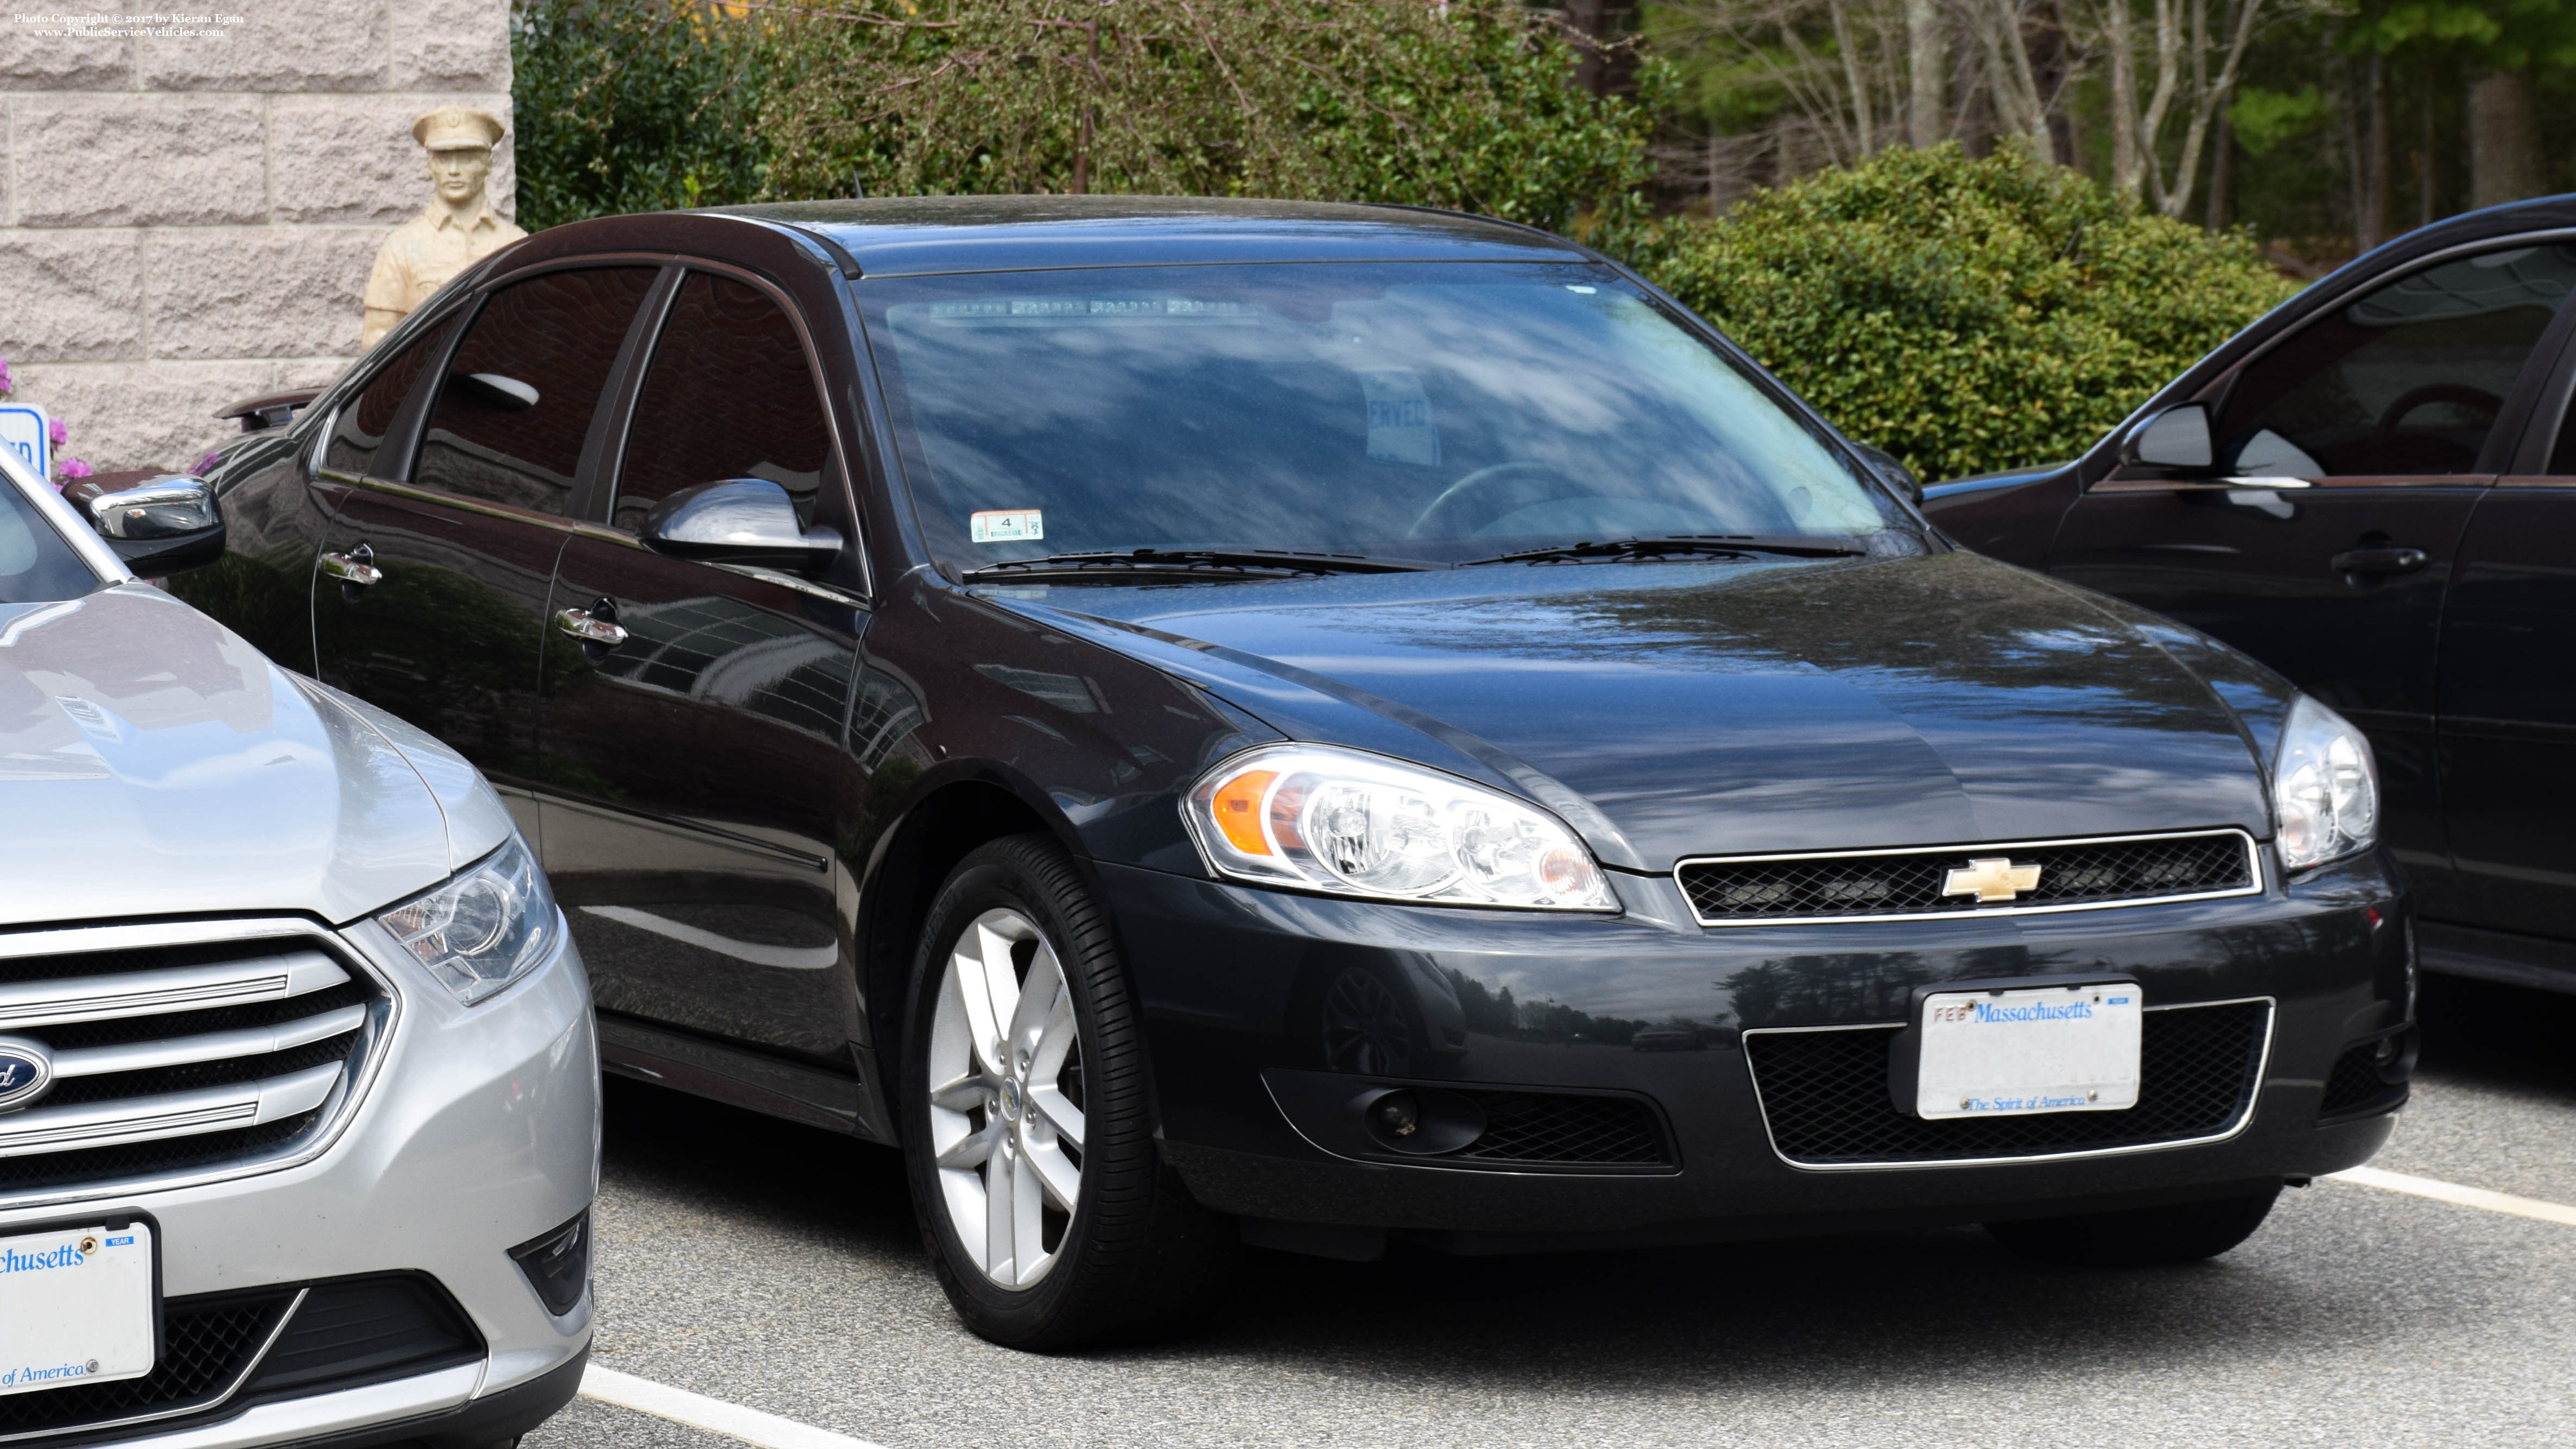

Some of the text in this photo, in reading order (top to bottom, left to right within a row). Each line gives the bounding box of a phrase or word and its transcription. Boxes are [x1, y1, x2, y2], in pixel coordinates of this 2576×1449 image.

[1001, 518, 1012, 527] 4
[1934, 1001, 2092, 1023] FEB Massachusetts
[1969, 1095, 2086, 1111] The Spirit of America
[111, 1237, 129, 1245] YEAR
[2, 1364, 84, 1387] of America
